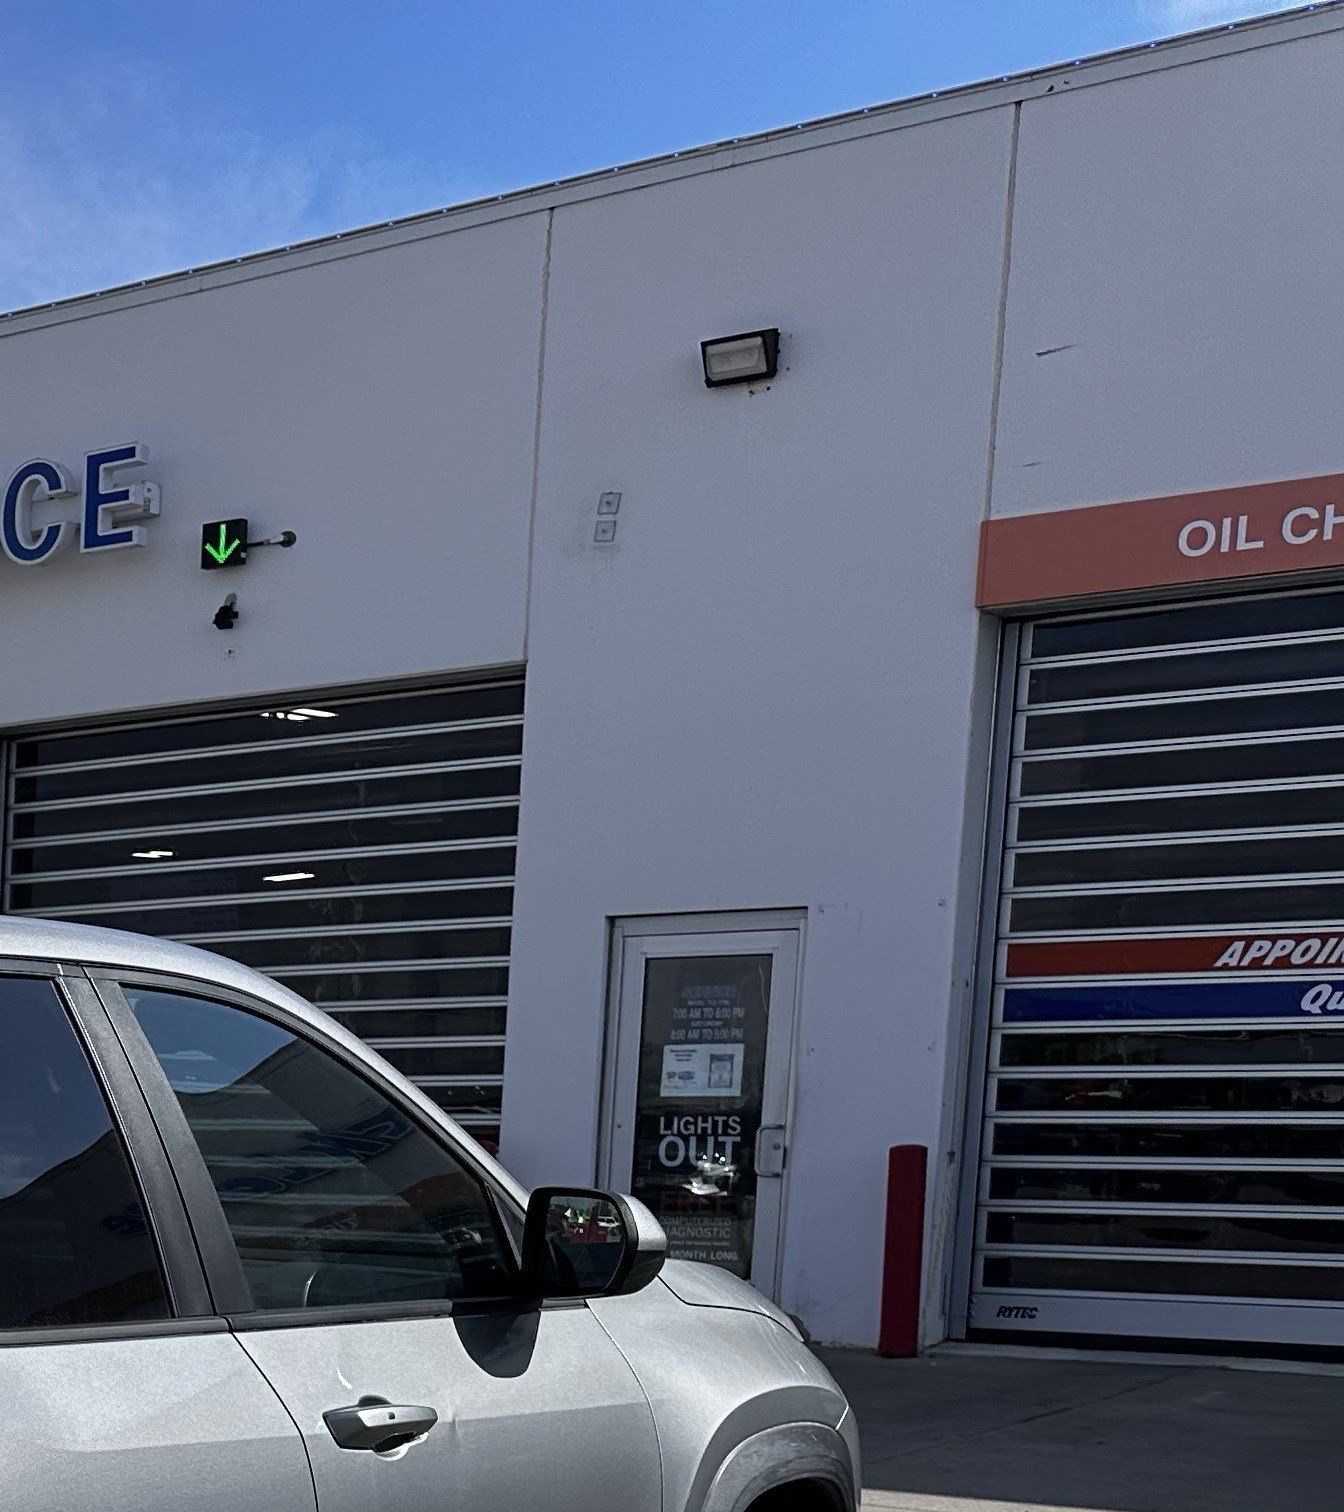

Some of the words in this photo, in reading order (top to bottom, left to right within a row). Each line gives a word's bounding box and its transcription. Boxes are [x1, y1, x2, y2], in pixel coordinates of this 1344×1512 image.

[1178, 514, 1264, 558] OIL
[659, 1115, 742, 1135] LIGHTS
[658, 1135, 741, 1168] OUT
